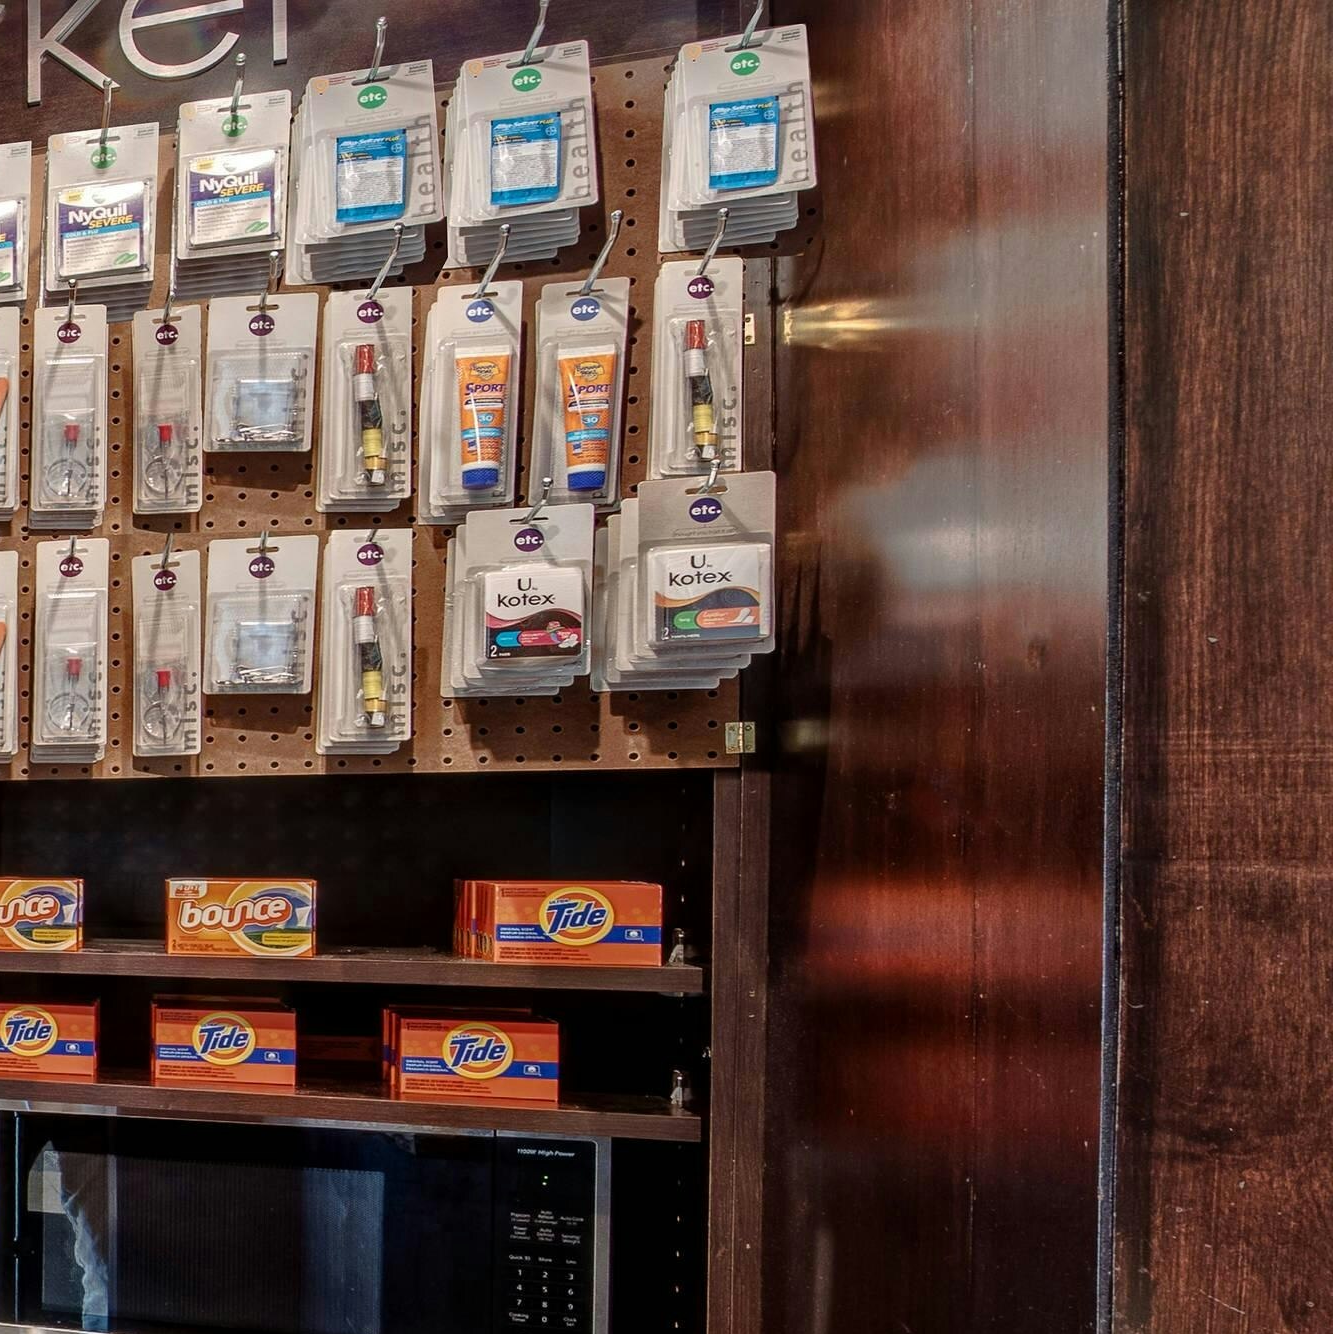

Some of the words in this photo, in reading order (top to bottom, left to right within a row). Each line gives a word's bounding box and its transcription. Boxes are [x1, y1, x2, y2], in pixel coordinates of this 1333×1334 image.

[732, 60, 760, 70] etc.
[514, 74, 541, 85] etc.
[360, 92, 387, 103] etc.
[778, 81, 810, 184] health
[561, 98, 591, 200] health
[407, 114, 437, 217] health
[199, 171, 258, 194] NyQuil
[220, 183, 264, 197] SEVERE
[68, 203, 127, 226] NyQuil
[89, 215, 133, 229] SEVERE
[464, 383, 505, 396] SPORT
[568, 383, 610, 397] SPORT
[479, 415, 494, 423] 30
[583, 416, 599, 424] 30
[184, 426, 199, 505] misc.
[691, 505, 722, 517] etc.
[515, 535, 544, 546] etc.
[691, 555, 706, 569] U
[518, 577, 533, 591] U
[490, 645, 498, 658] 2
[184, 671, 198, 750] misc.
[179, 898, 290, 930] bounce
[546, 901, 608, 936] Tide
[4, 1014, 52, 1046] Tide
[198, 1026, 249, 1055] Tide
[449, 1036, 507, 1068] Tide
